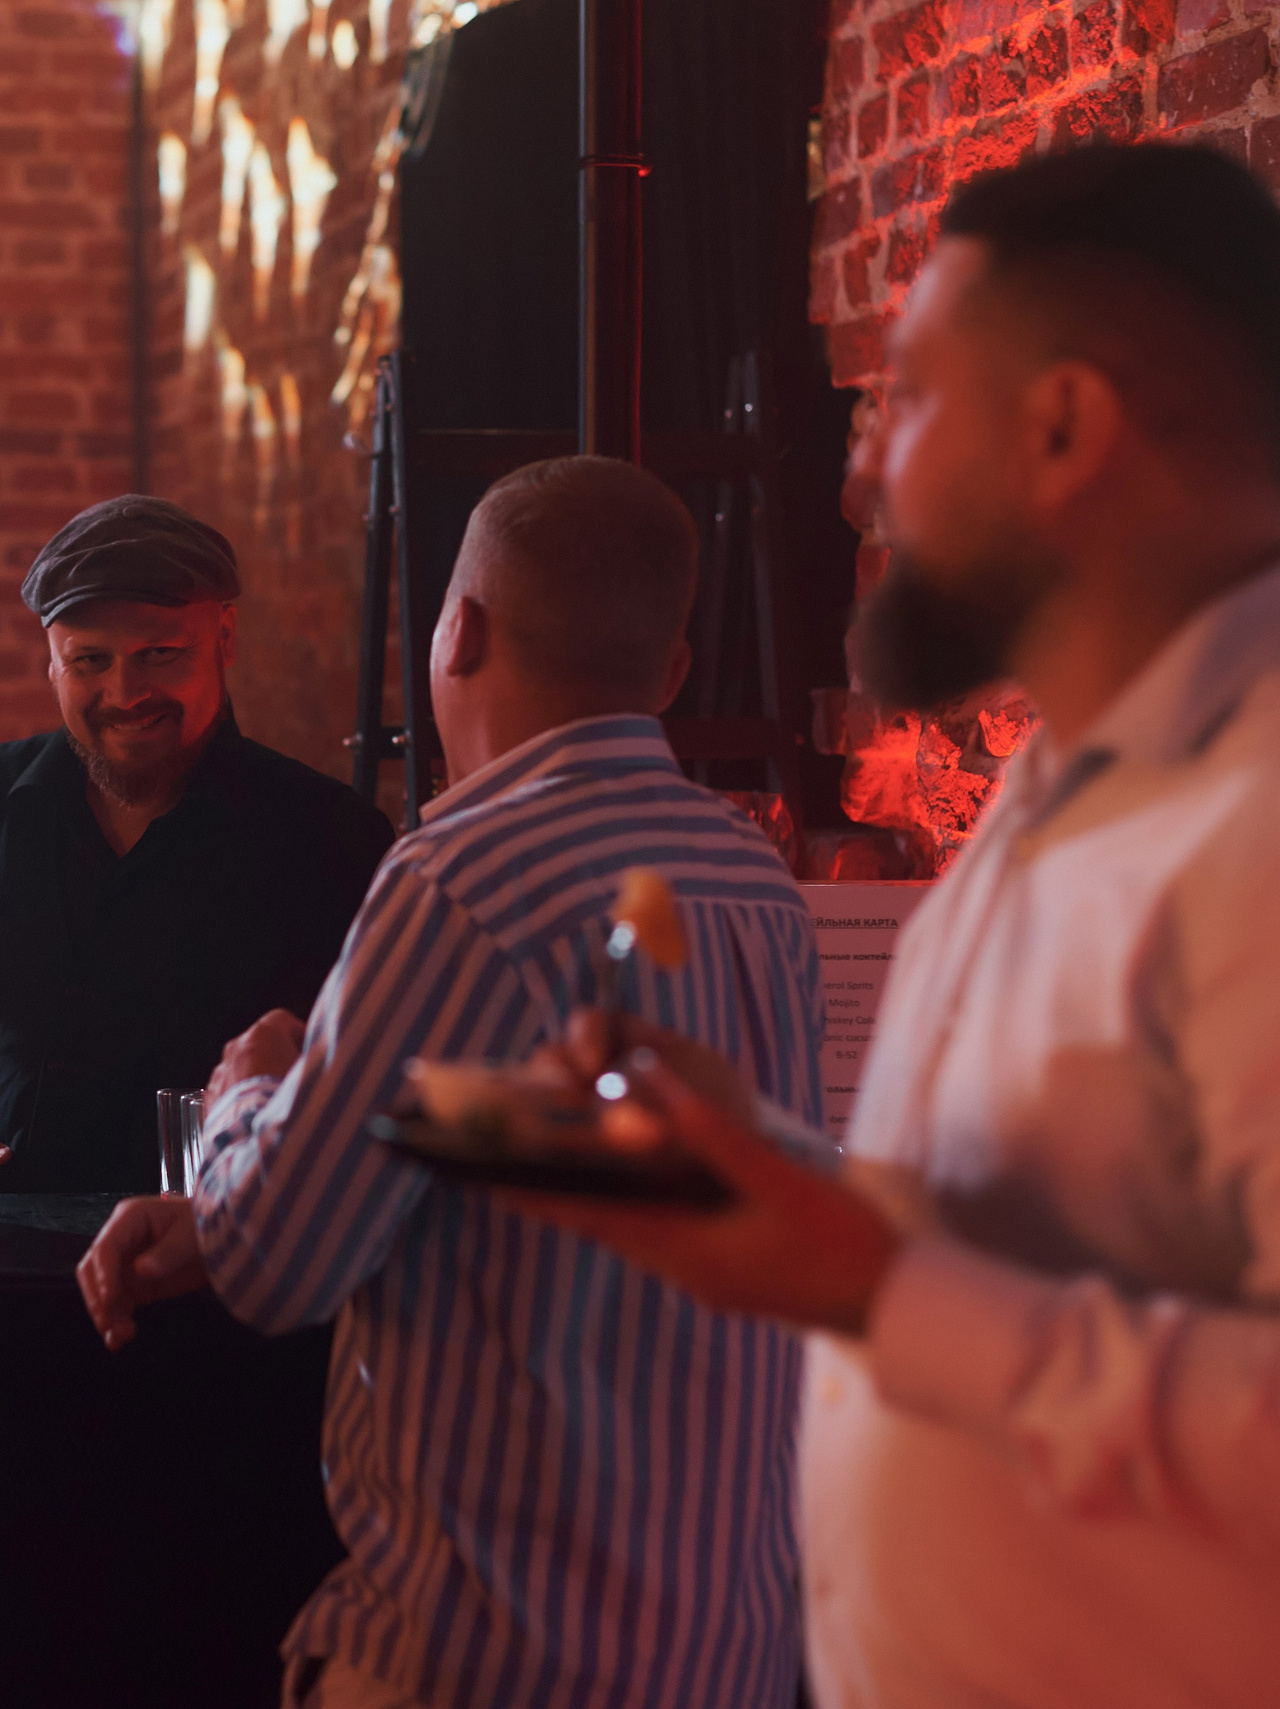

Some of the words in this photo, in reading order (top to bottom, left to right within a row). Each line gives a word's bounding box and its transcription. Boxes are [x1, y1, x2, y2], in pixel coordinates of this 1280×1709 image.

[812, 917, 861, 928] ЕЙЛЬНАЯ
[863, 918, 899, 928] КАРТА
[853, 952, 893, 961] коктейл
[828, 999, 860, 1008] Mojito
[836, 1051, 858, 1060] B-52
